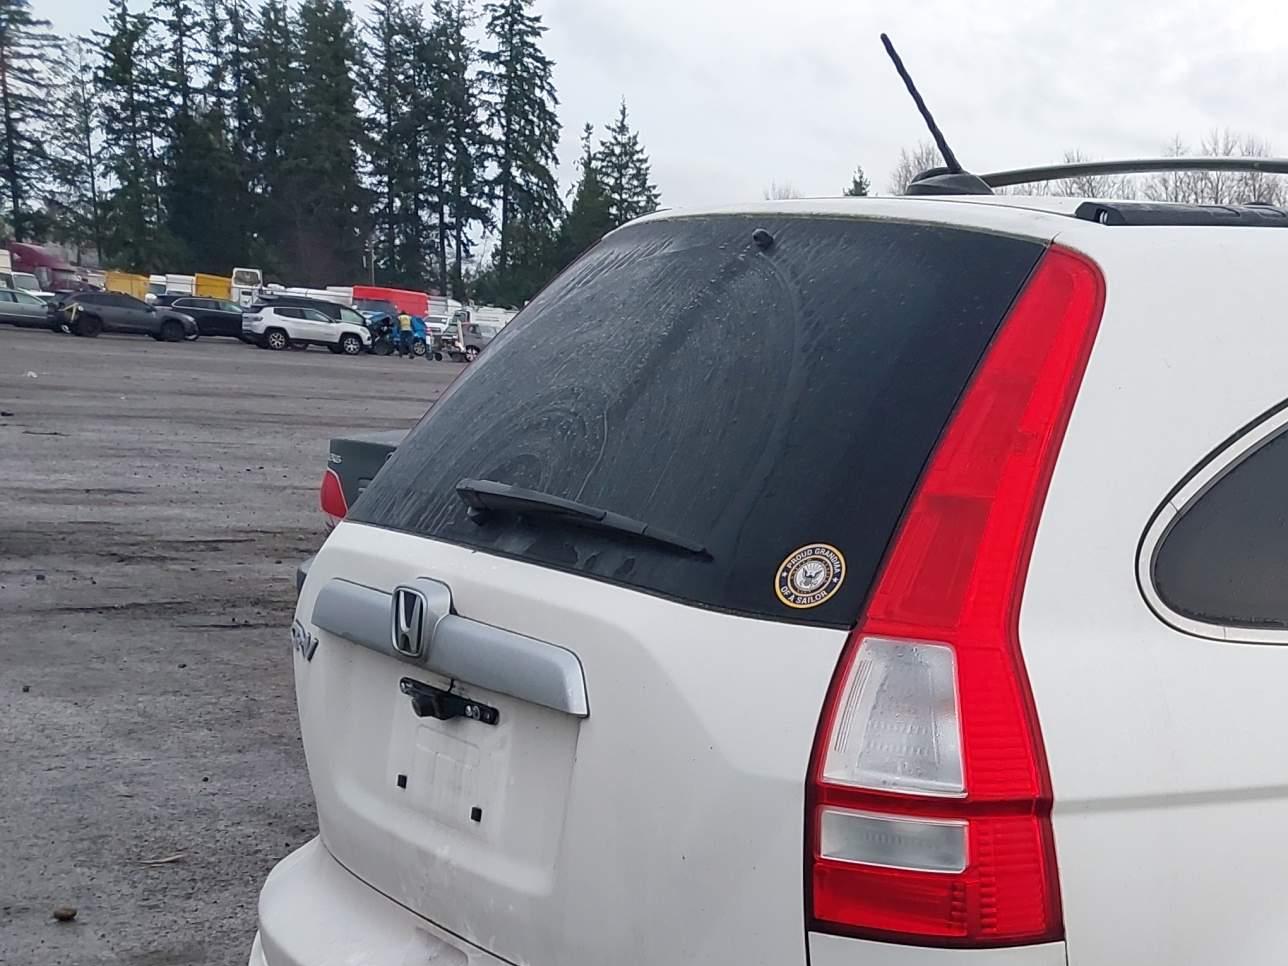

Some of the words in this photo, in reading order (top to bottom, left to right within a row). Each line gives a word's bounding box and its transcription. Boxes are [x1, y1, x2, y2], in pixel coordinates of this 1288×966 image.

[787, 549, 813, 569] PROUD
[814, 547, 841, 574] GRANDMA
[781, 586, 792, 596] OF
[795, 590, 828, 604] SAILOR
